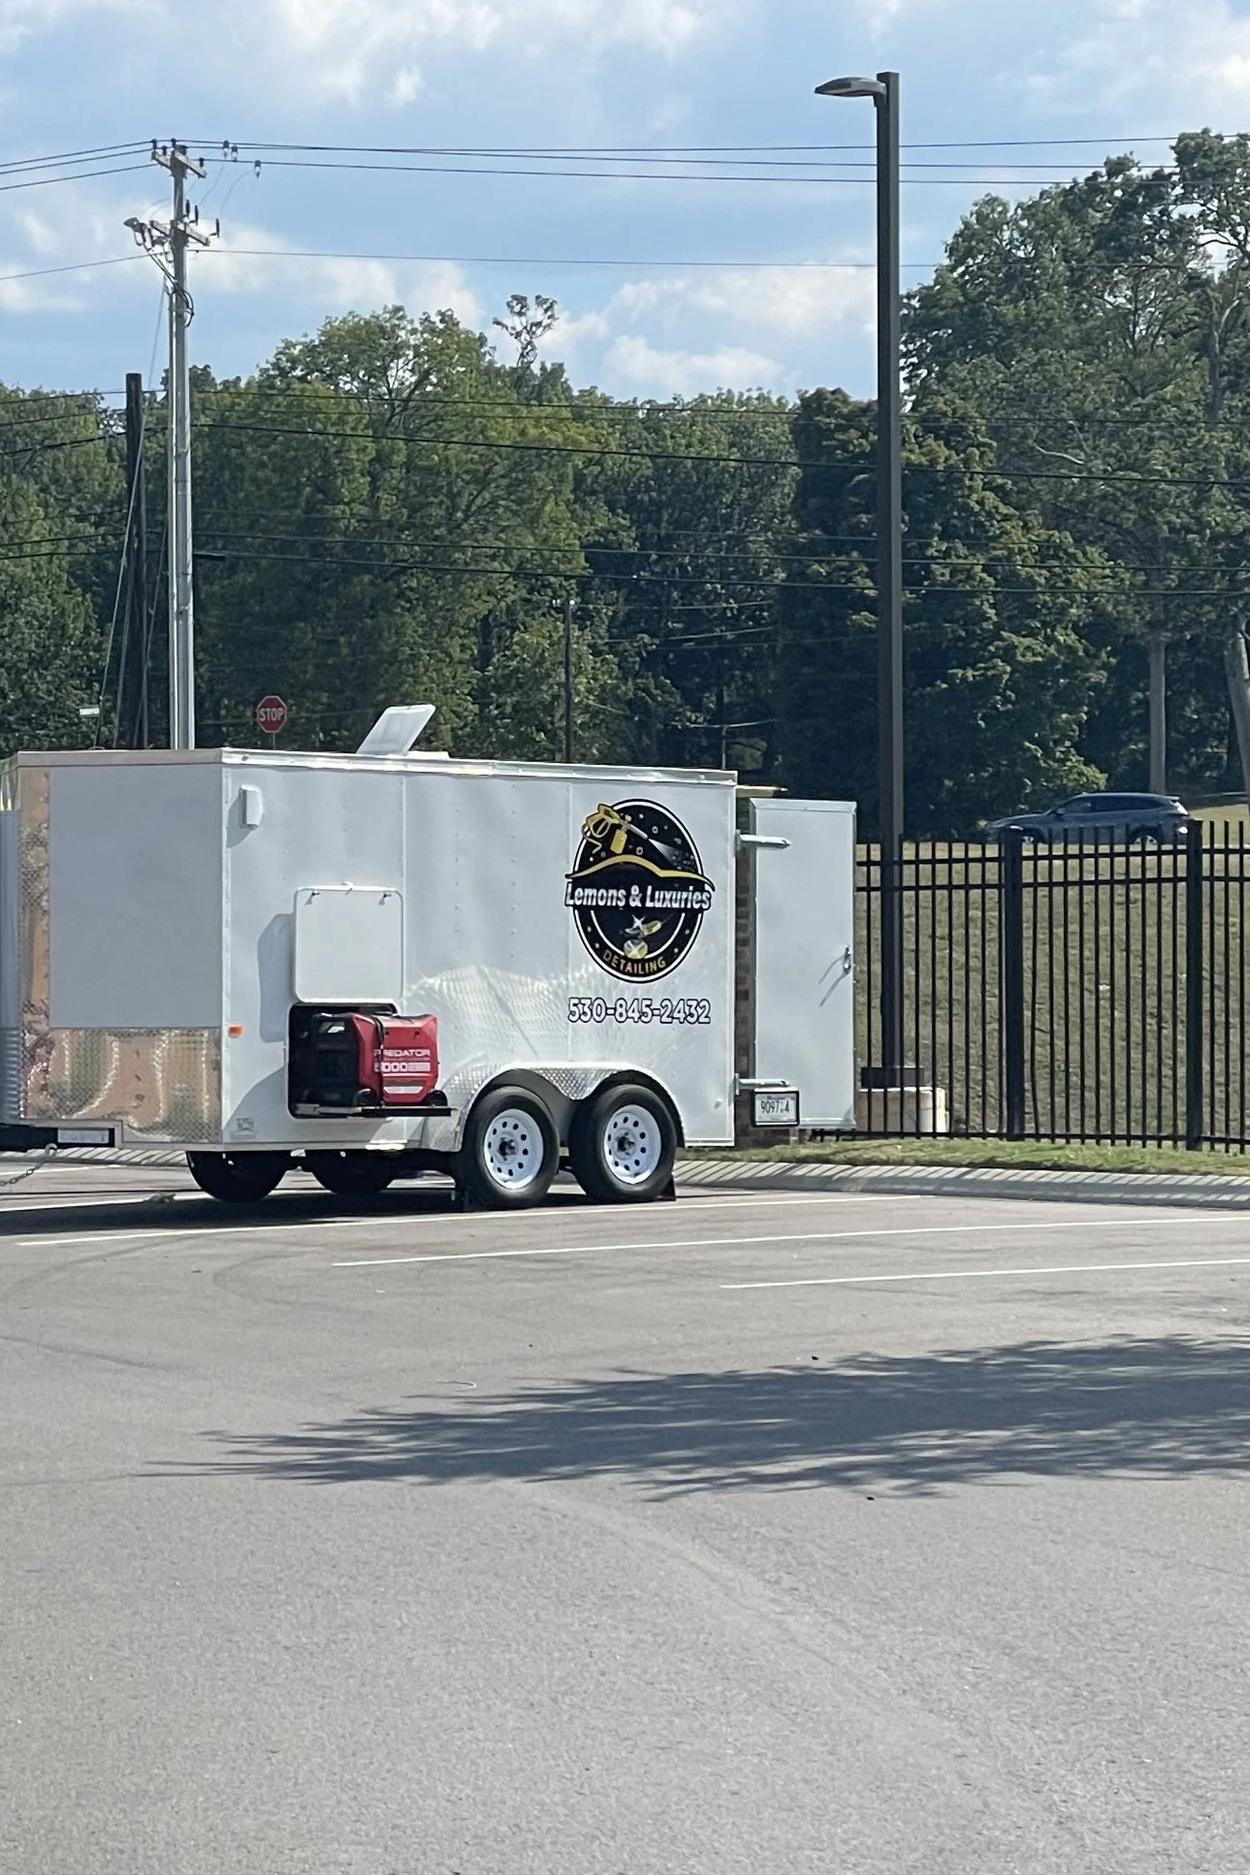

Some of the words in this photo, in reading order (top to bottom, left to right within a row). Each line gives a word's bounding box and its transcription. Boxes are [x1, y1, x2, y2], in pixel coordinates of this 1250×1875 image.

[260, 707, 284, 722] STOP
[565, 883, 627, 906] Lemons
[628, 884, 643, 908] &
[645, 885, 711, 910] Luxuries
[603, 949, 666, 974] DETAILING
[568, 997, 711, 1025] 530-845-2432
